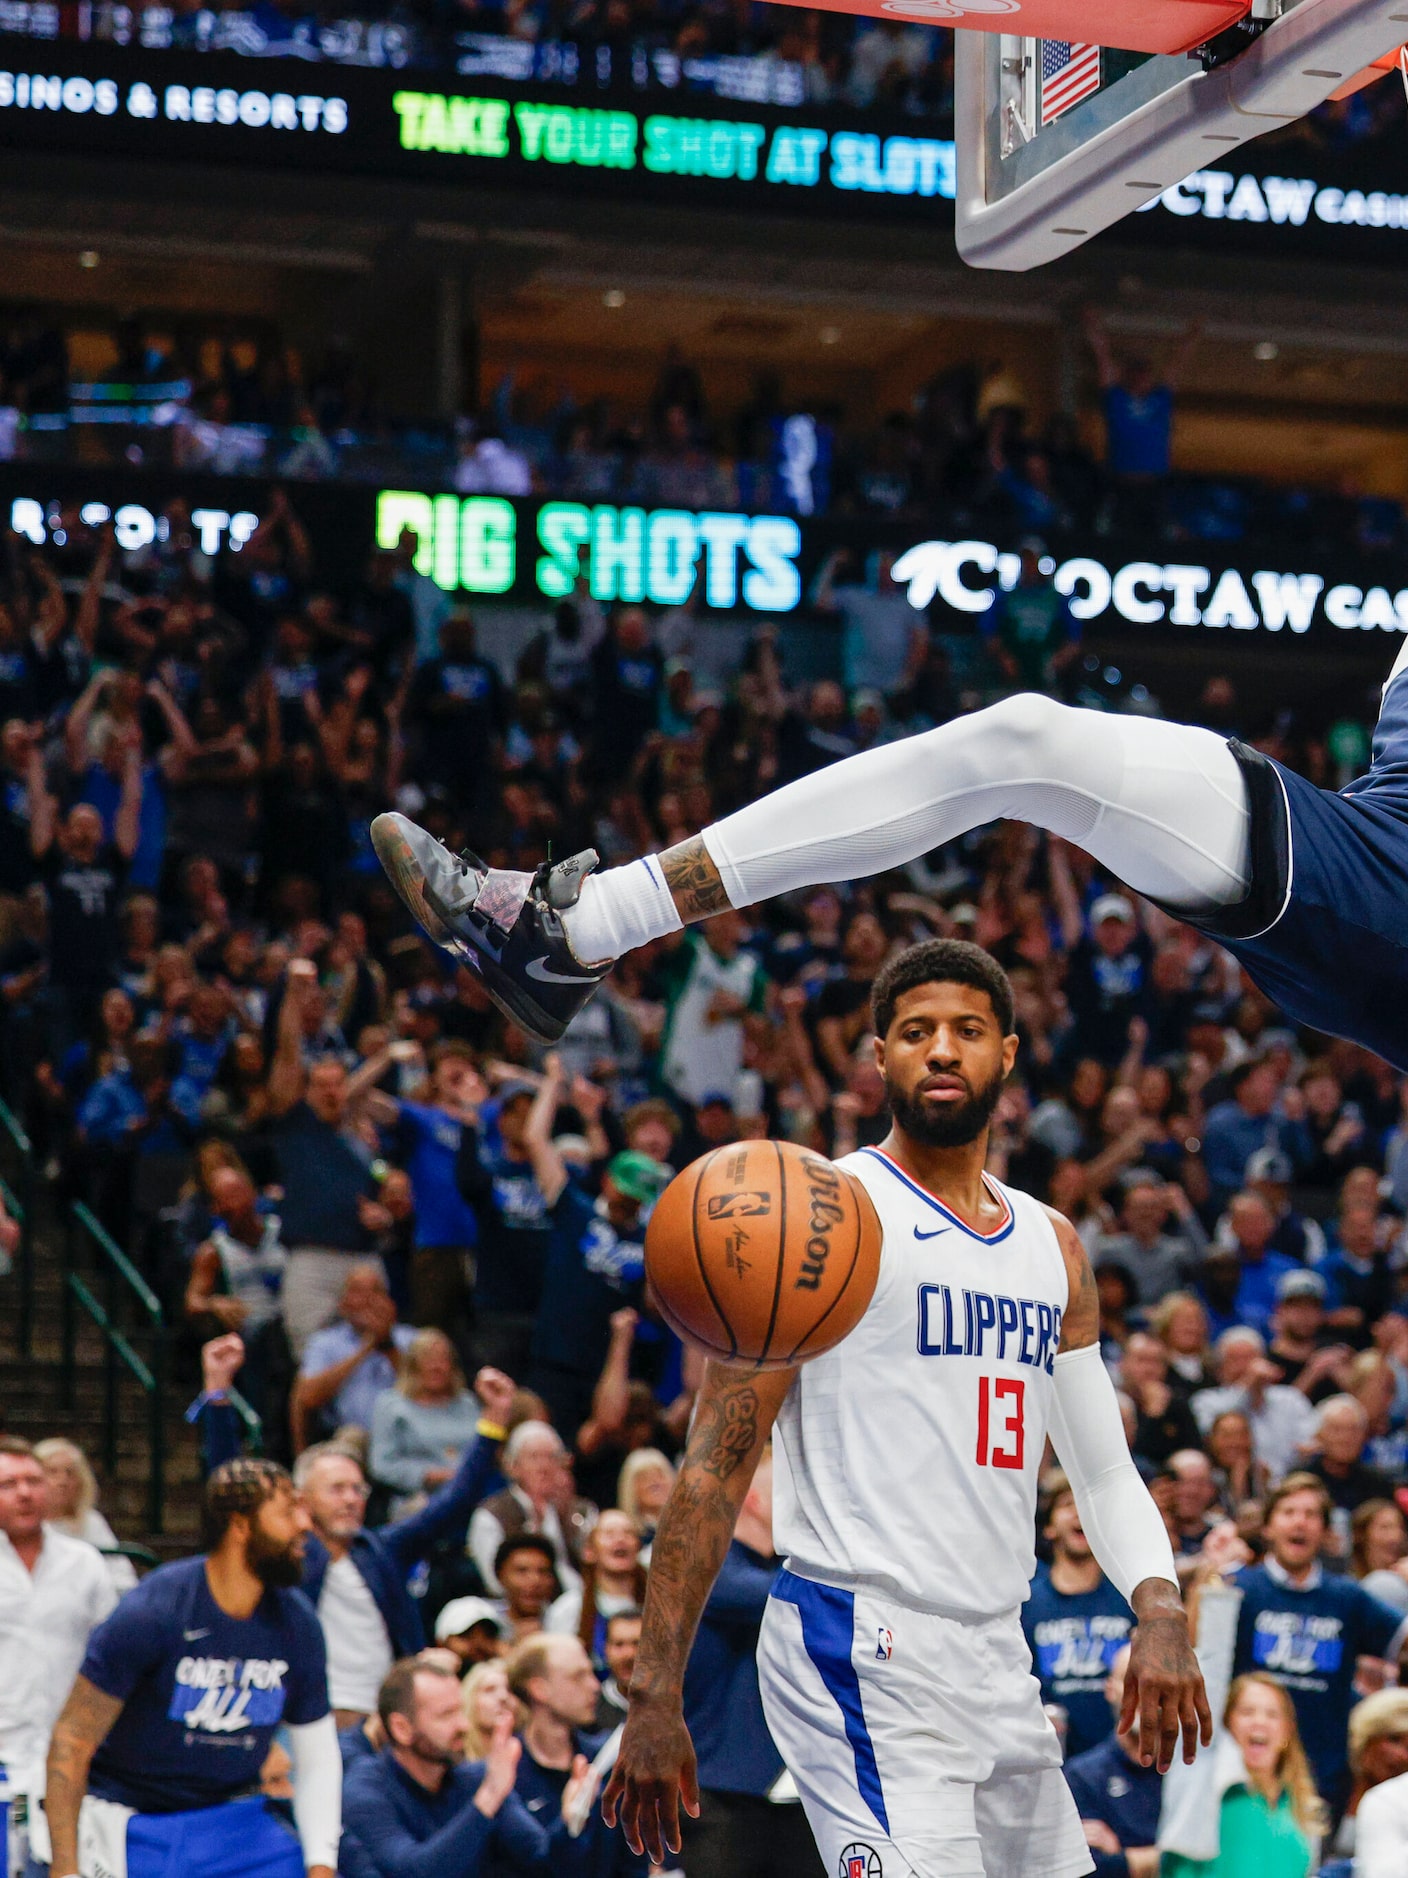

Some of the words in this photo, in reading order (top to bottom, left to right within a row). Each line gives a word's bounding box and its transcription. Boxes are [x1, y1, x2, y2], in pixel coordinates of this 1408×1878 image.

[126, 81, 158, 120] &
[164, 84, 348, 135] RESORTS
[393, 90, 509, 158] TAKE
[514, 101, 638, 169] YOUR
[643, 114, 765, 181] SHOT
[765, 126, 827, 187] AT
[535, 501, 800, 613] SHOTS
[795, 1154, 846, 1292] Wilson
[975, 1376, 1025, 1470] 13
